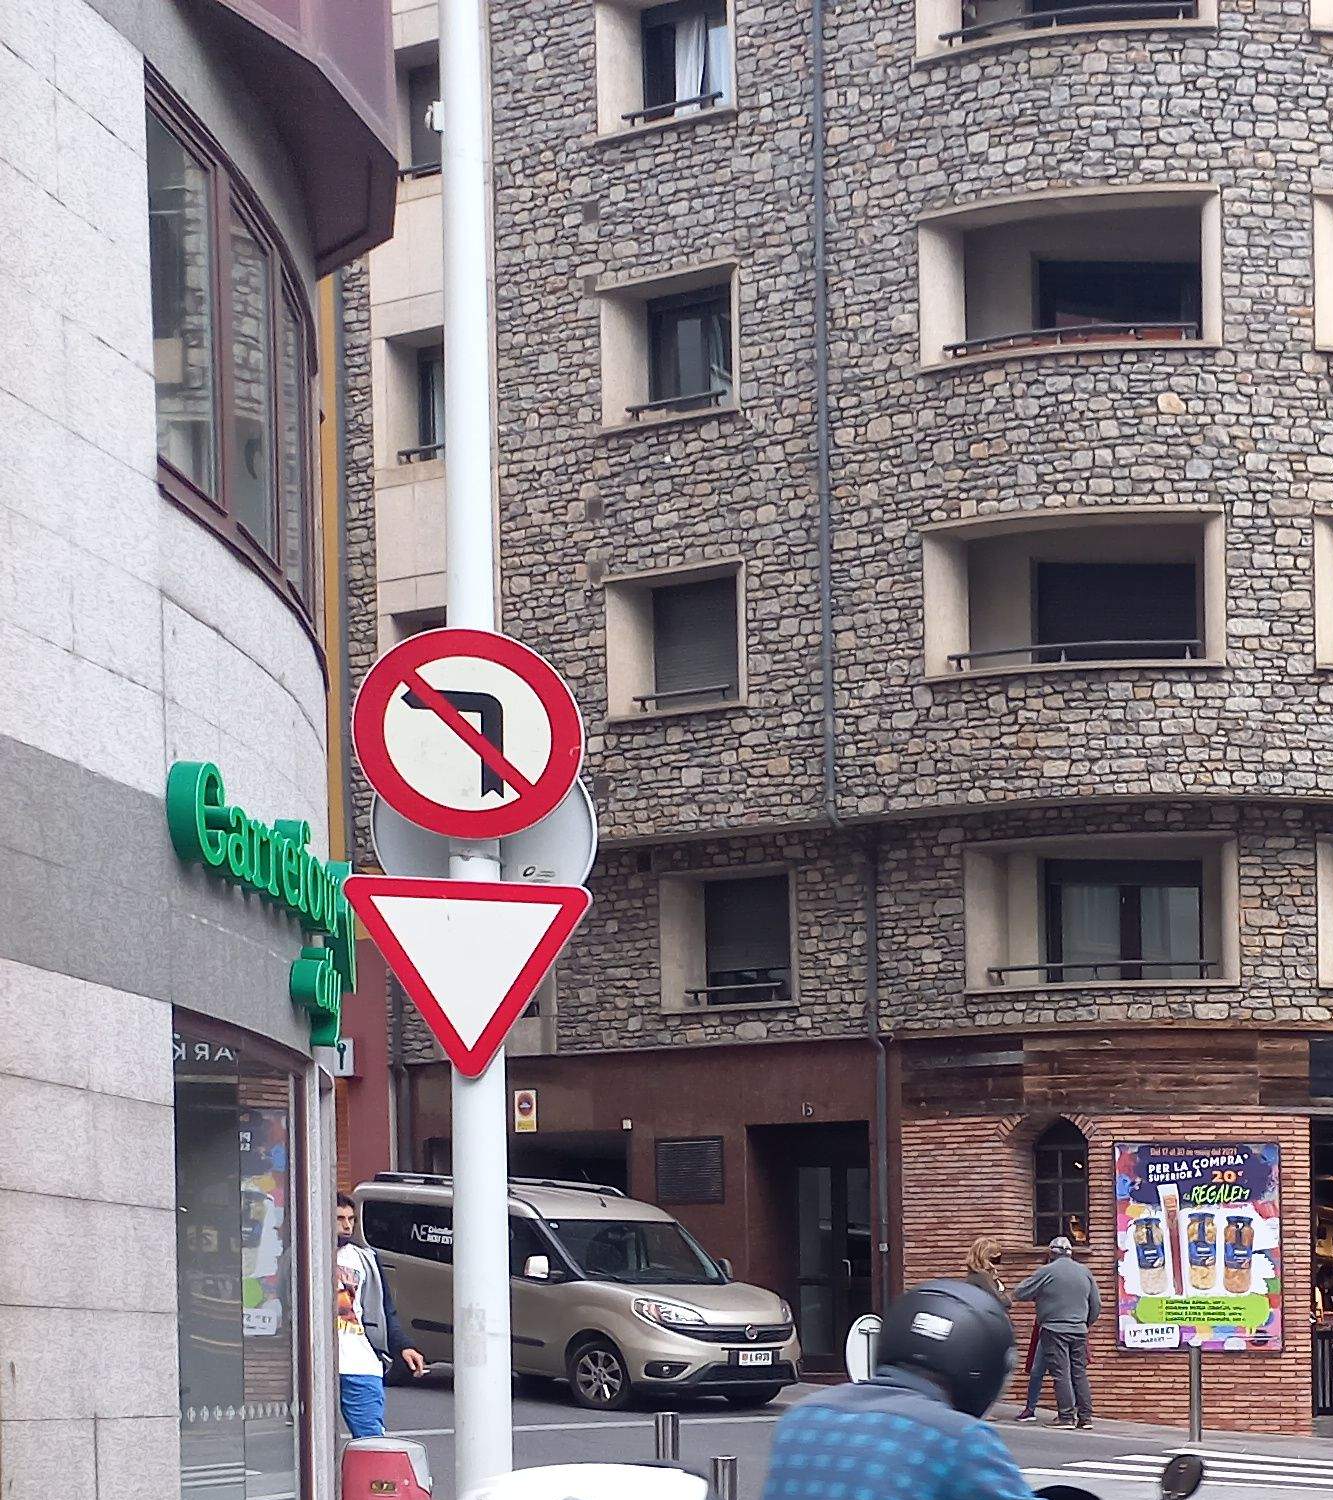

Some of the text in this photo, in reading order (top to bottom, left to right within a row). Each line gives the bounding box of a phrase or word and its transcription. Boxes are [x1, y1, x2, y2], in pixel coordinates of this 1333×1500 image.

[170, 761, 340, 939] Carrefour
[1148, 1163, 1170, 1174] PER
[1174, 1161, 1189, 1172] LA
[1148, 1170, 1193, 1182] SUPERIOR
[1191, 1184, 1251, 1204] REGALEM
